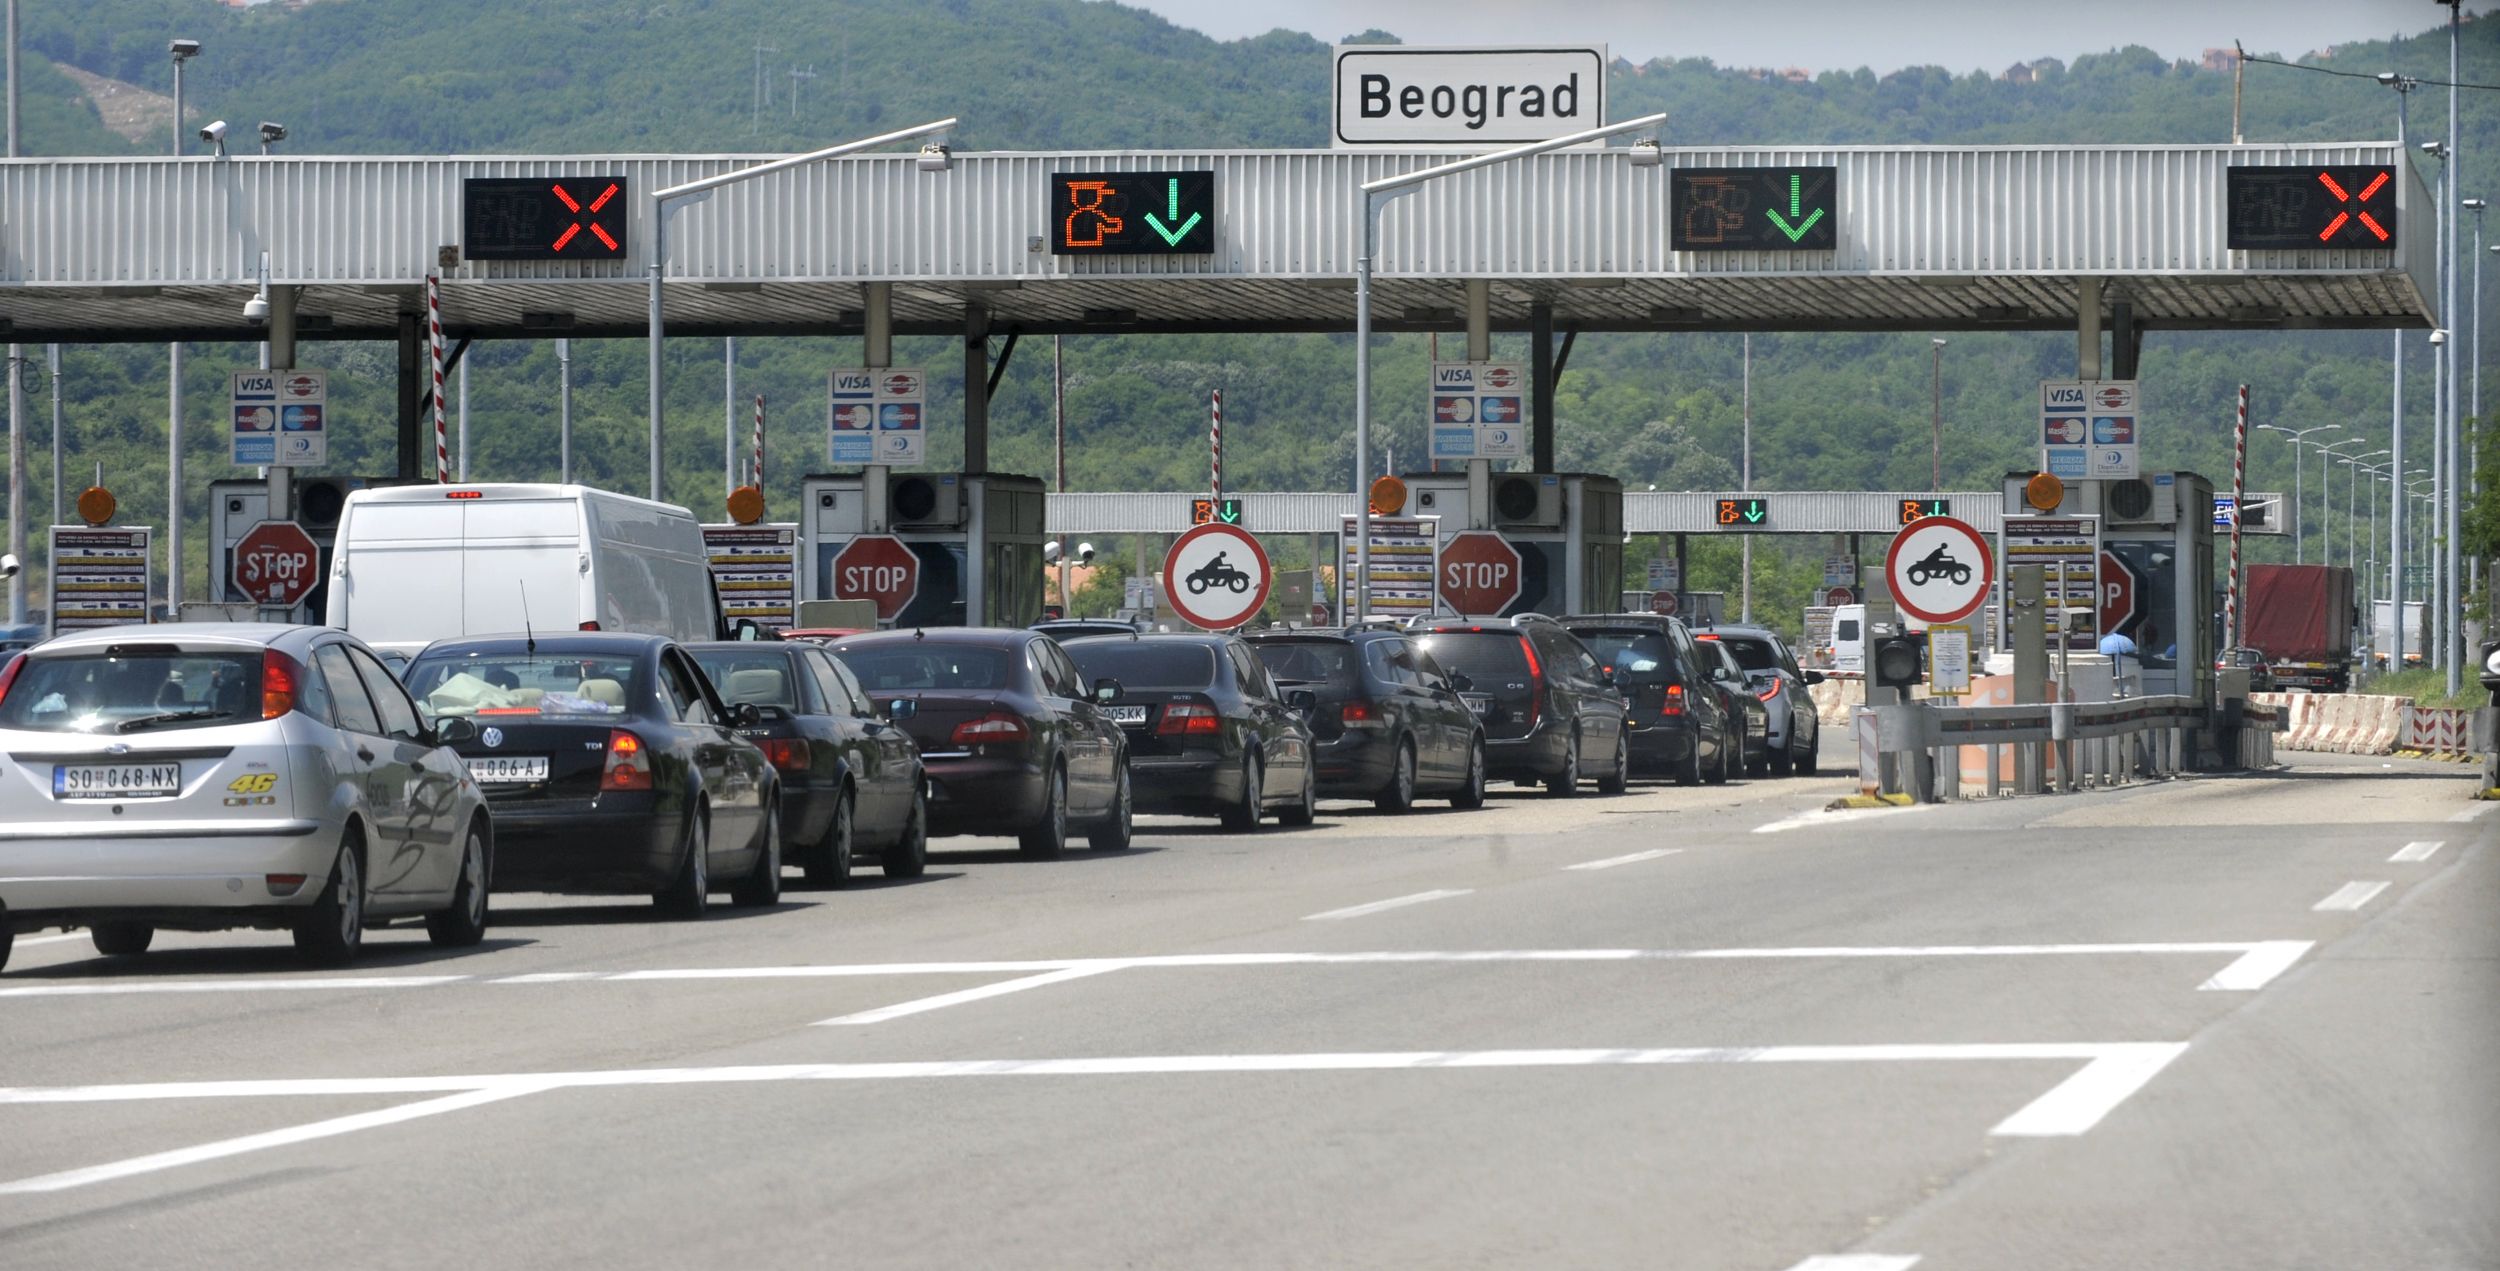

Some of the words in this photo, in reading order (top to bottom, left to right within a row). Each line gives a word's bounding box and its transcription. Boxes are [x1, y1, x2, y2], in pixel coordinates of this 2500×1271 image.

[1361, 73, 1578, 130] Beograd
[241, 378, 274, 391] VISA
[839, 376, 871, 389] VISA
[1440, 369, 1473, 382] VISA
[2050, 389, 2084, 402] VISA
[247, 552, 308, 580] STOP
[1447, 562, 1510, 589] STOP
[844, 566, 907, 592] STOP
[584, 742, 603, 751] TDI
[69, 769, 92, 789] SO
[226, 773, 278, 795] 46
